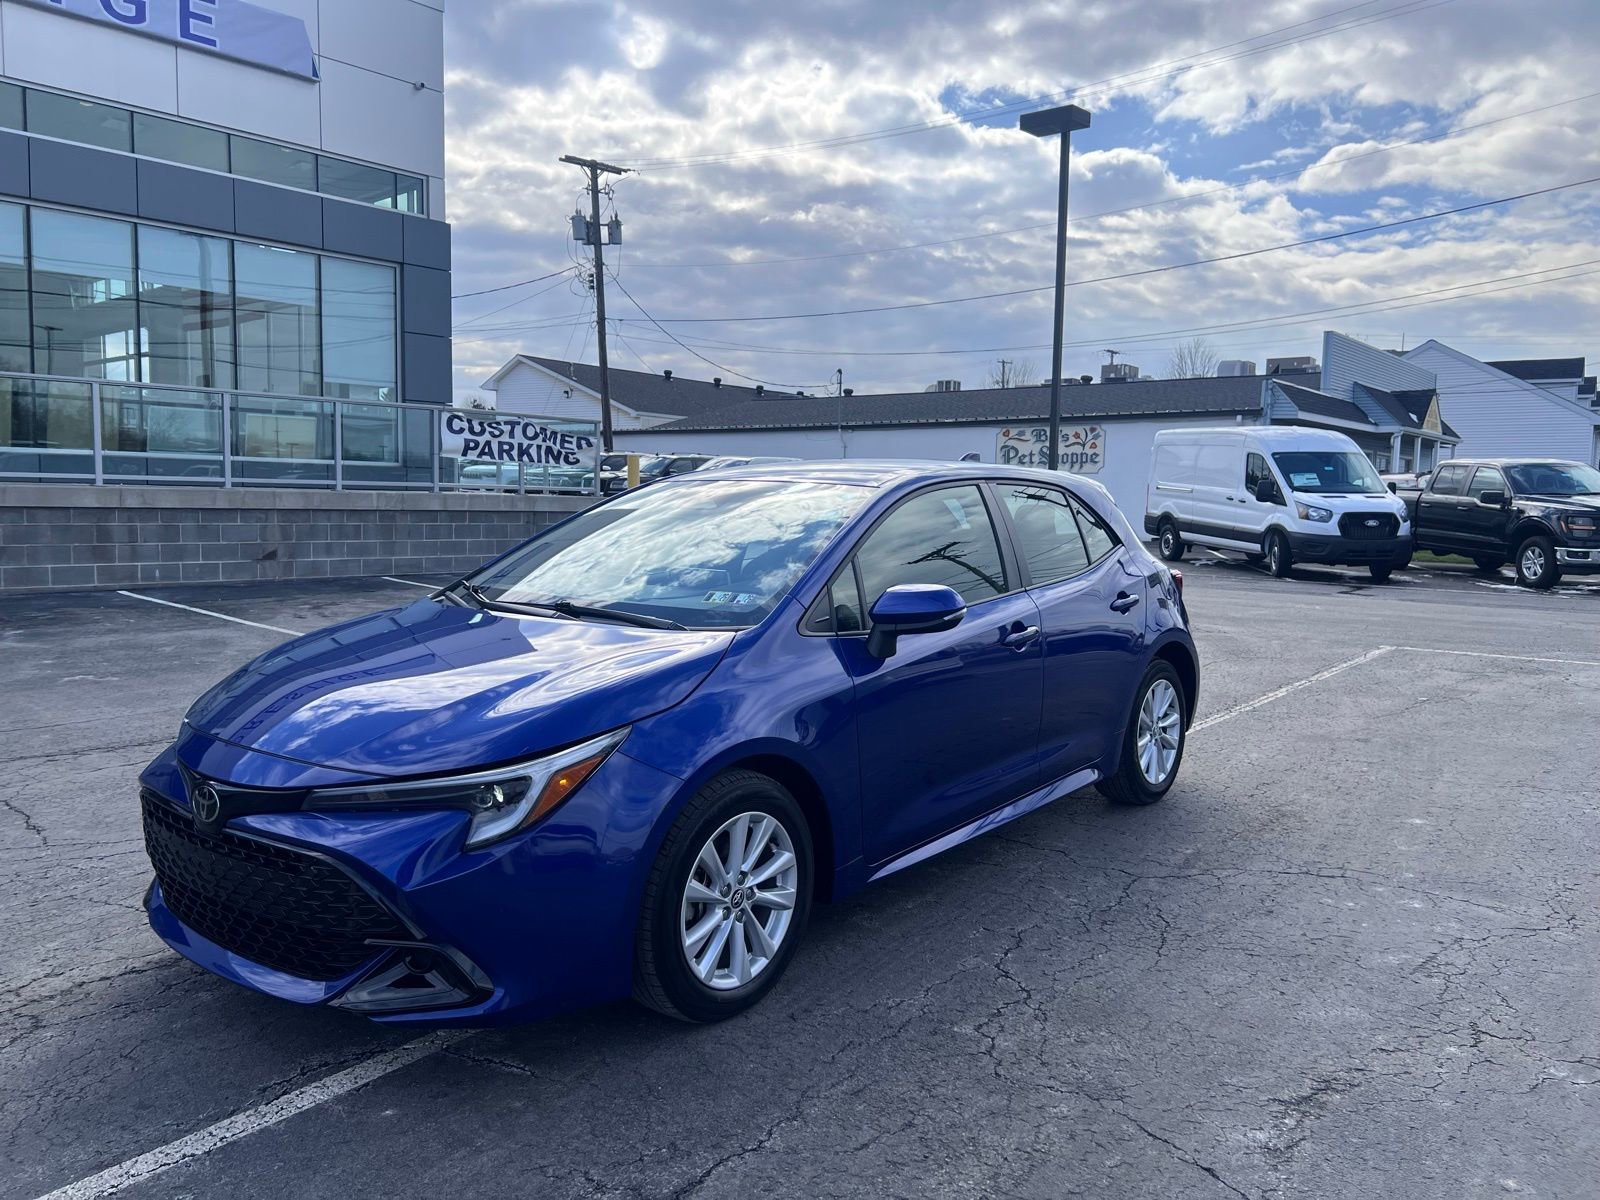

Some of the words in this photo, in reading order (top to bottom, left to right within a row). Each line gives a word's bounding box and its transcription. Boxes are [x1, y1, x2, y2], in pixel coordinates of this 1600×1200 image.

[446, 413, 594, 451] CUSTOMER
[461, 437, 581, 466] PARKING
[1000, 444, 1036, 465] Pet
[1037, 445, 1100, 470] Soppe
